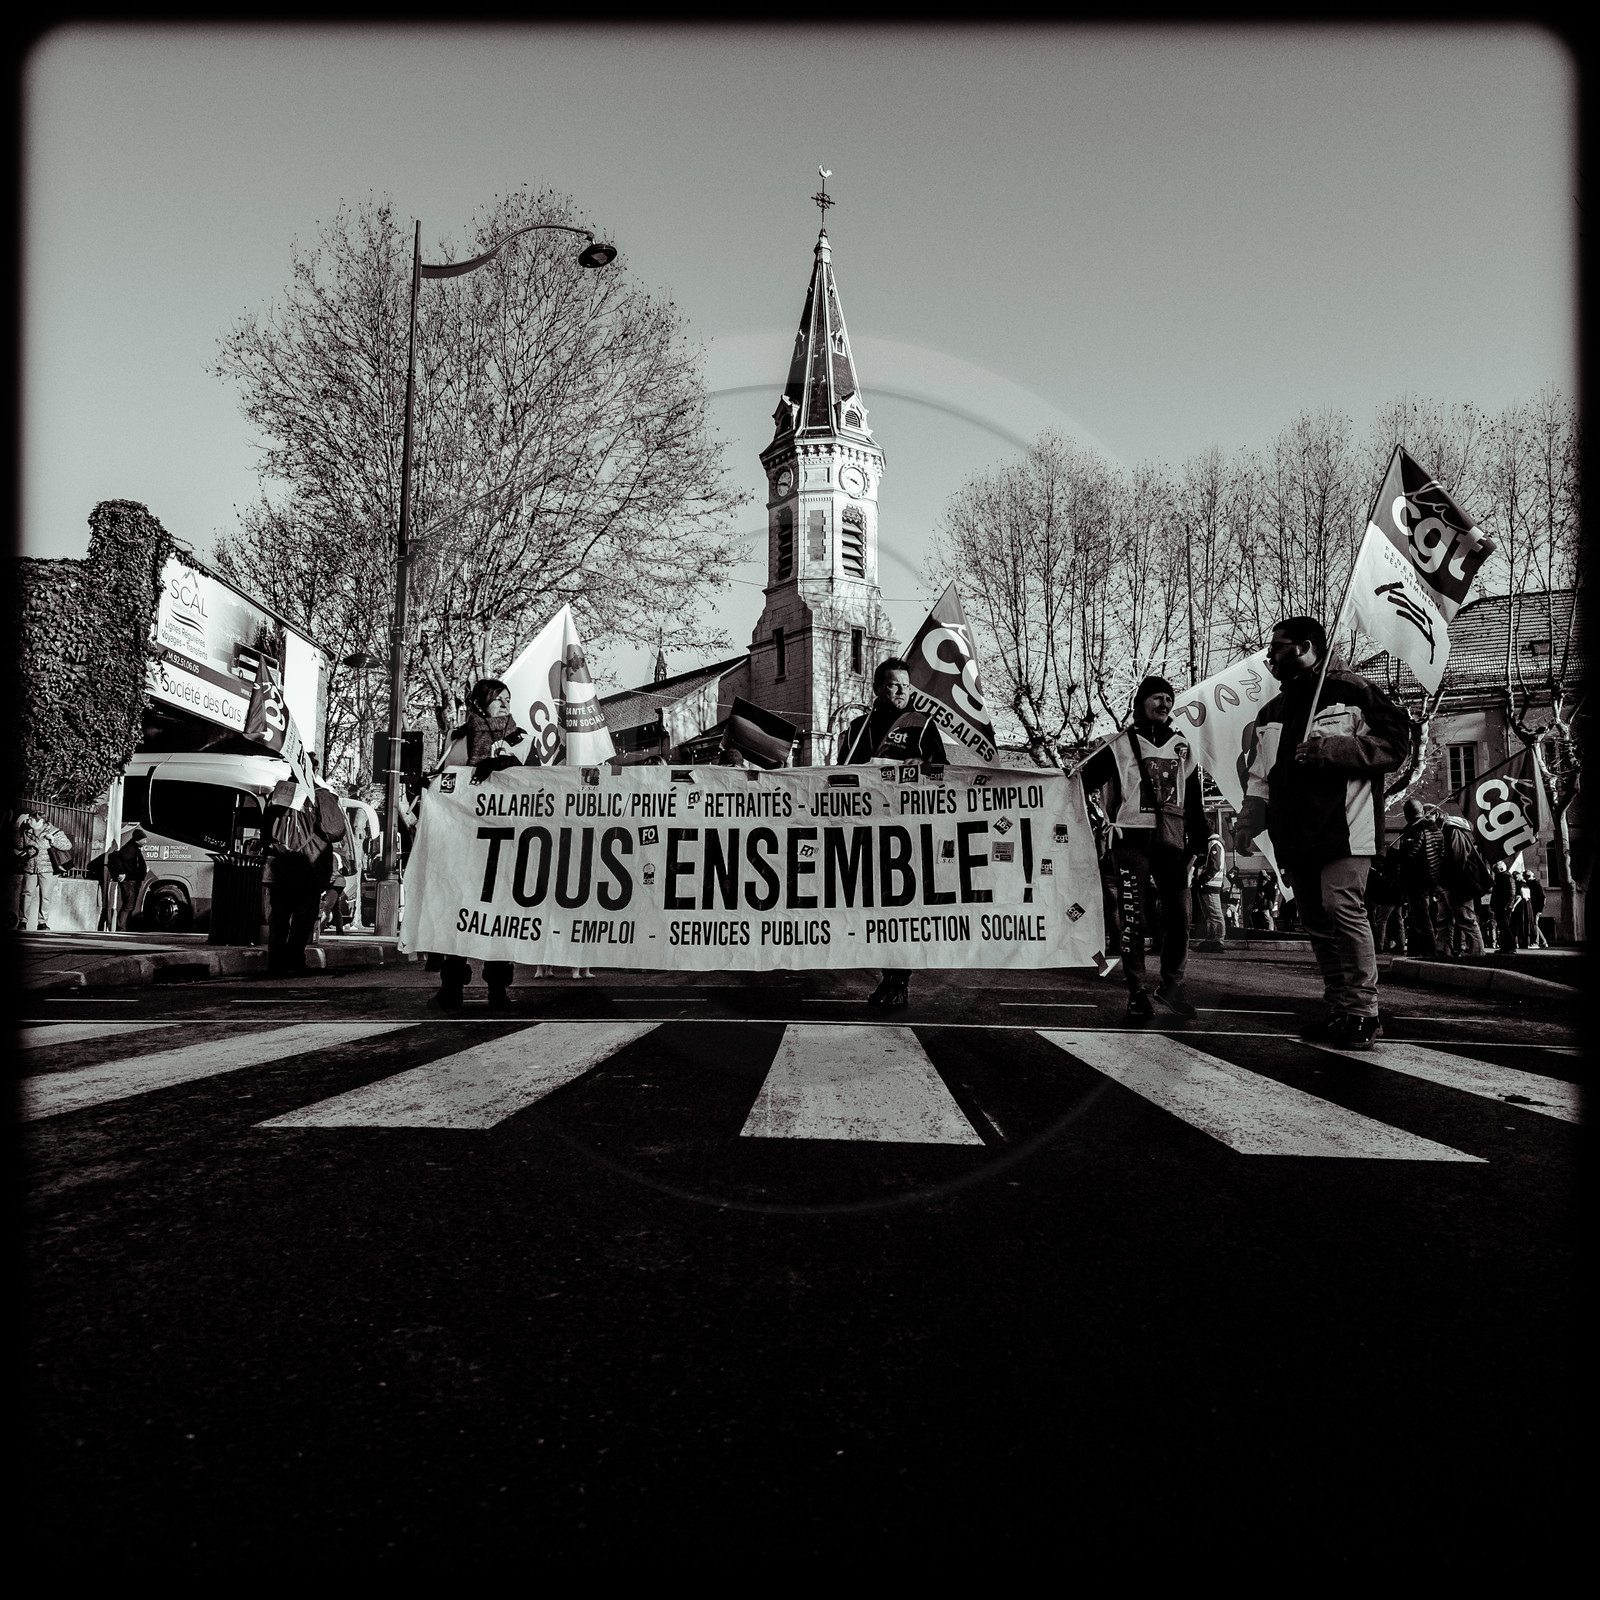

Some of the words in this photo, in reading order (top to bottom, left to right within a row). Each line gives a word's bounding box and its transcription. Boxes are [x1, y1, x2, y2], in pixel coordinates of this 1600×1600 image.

[1391, 495, 1487, 581] cgt
[170, 578, 209, 619] SCAL
[165, 618, 181, 635] Lignes
[921, 627, 991, 726] cg
[162, 672, 201, 706] Société
[203, 690, 220, 714] des
[221, 699, 242, 723] Cars
[587, 704, 597, 714] ET
[529, 700, 562, 765] cg
[909, 690, 996, 763] AUTES-ALPES
[888, 730, 908, 745] cgt
[881, 769, 896, 778] cgt
[902, 767, 916, 779] FO
[441, 777, 456, 789] cgt
[475, 788, 555, 817] SALARIÉS
[565, 786, 677, 818] PUBLIC/PRIVÉ
[704, 786, 792, 818] RETRAITÉS
[810, 791, 872, 817] JEUNES
[900, 784, 957, 815] PRIVÉS
[967, 785, 1044, 813] D'EMPLOI
[1475, 778, 1536, 856] cgt
[642, 828, 656, 840] FO
[996, 820, 1011, 832] cgt
[1055, 835, 1069, 843] cgt
[476, 825, 634, 911] TOUS
[664, 820, 993, 911] ENSEMBLE
[1041, 862, 1053, 871] cgt
[1068, 905, 1083, 919] cgt
[457, 908, 542, 941] SALAIRES
[570, 919, 635, 944] EMPLOI
[669, 920, 750, 946] SERVICES
[761, 919, 831, 946] PUBLICS
[866, 915, 970, 943] PROTECTION
[981, 914, 1047, 941] SOCIALE
